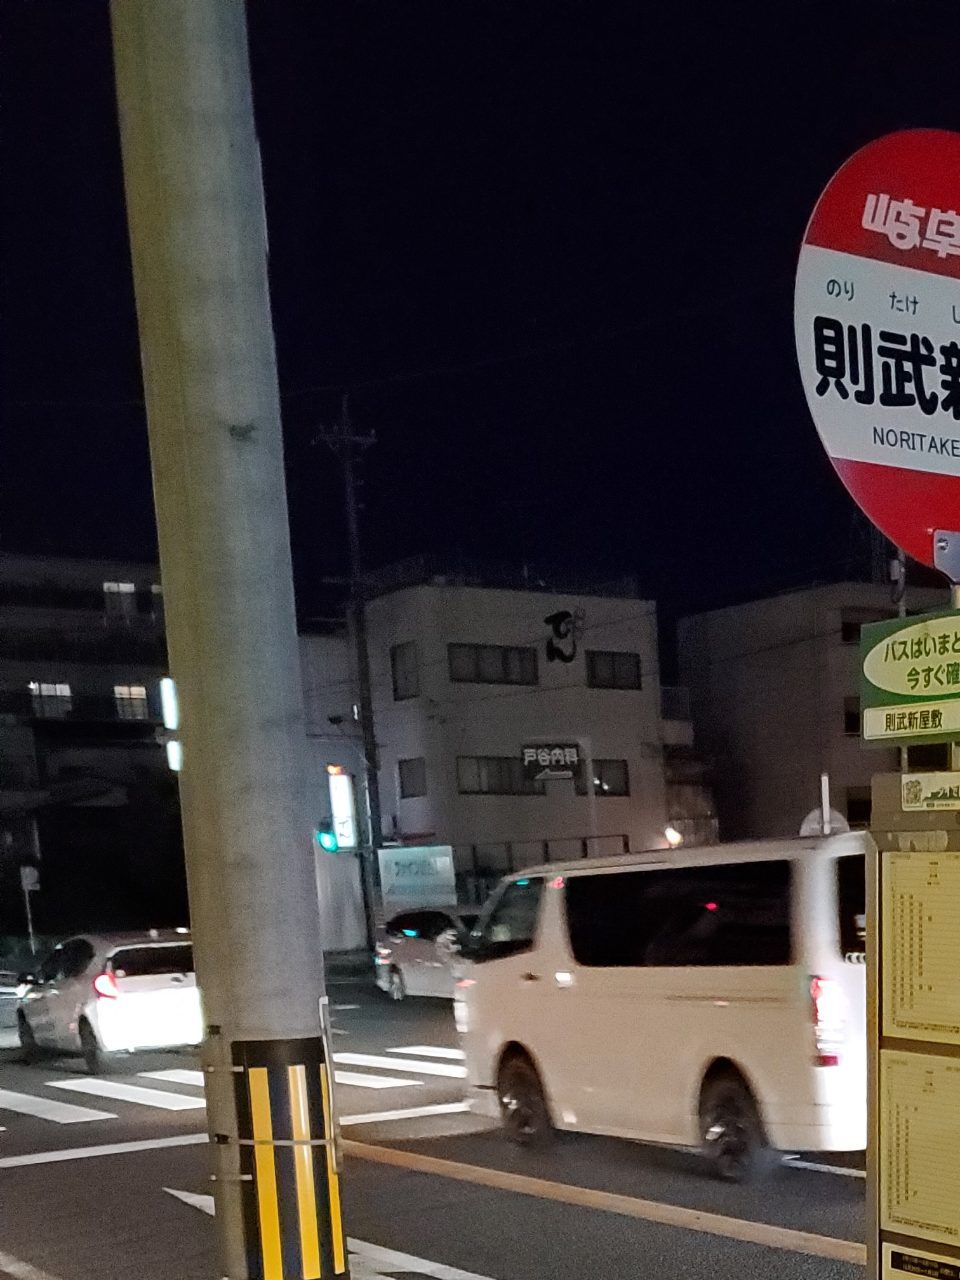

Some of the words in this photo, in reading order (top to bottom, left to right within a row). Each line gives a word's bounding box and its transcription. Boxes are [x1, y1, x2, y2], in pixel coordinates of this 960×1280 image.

[825, 277, 855, 302] のり
[889, 290, 919, 316] たけ
[884, 710, 943, 732] 則武新屋敷
